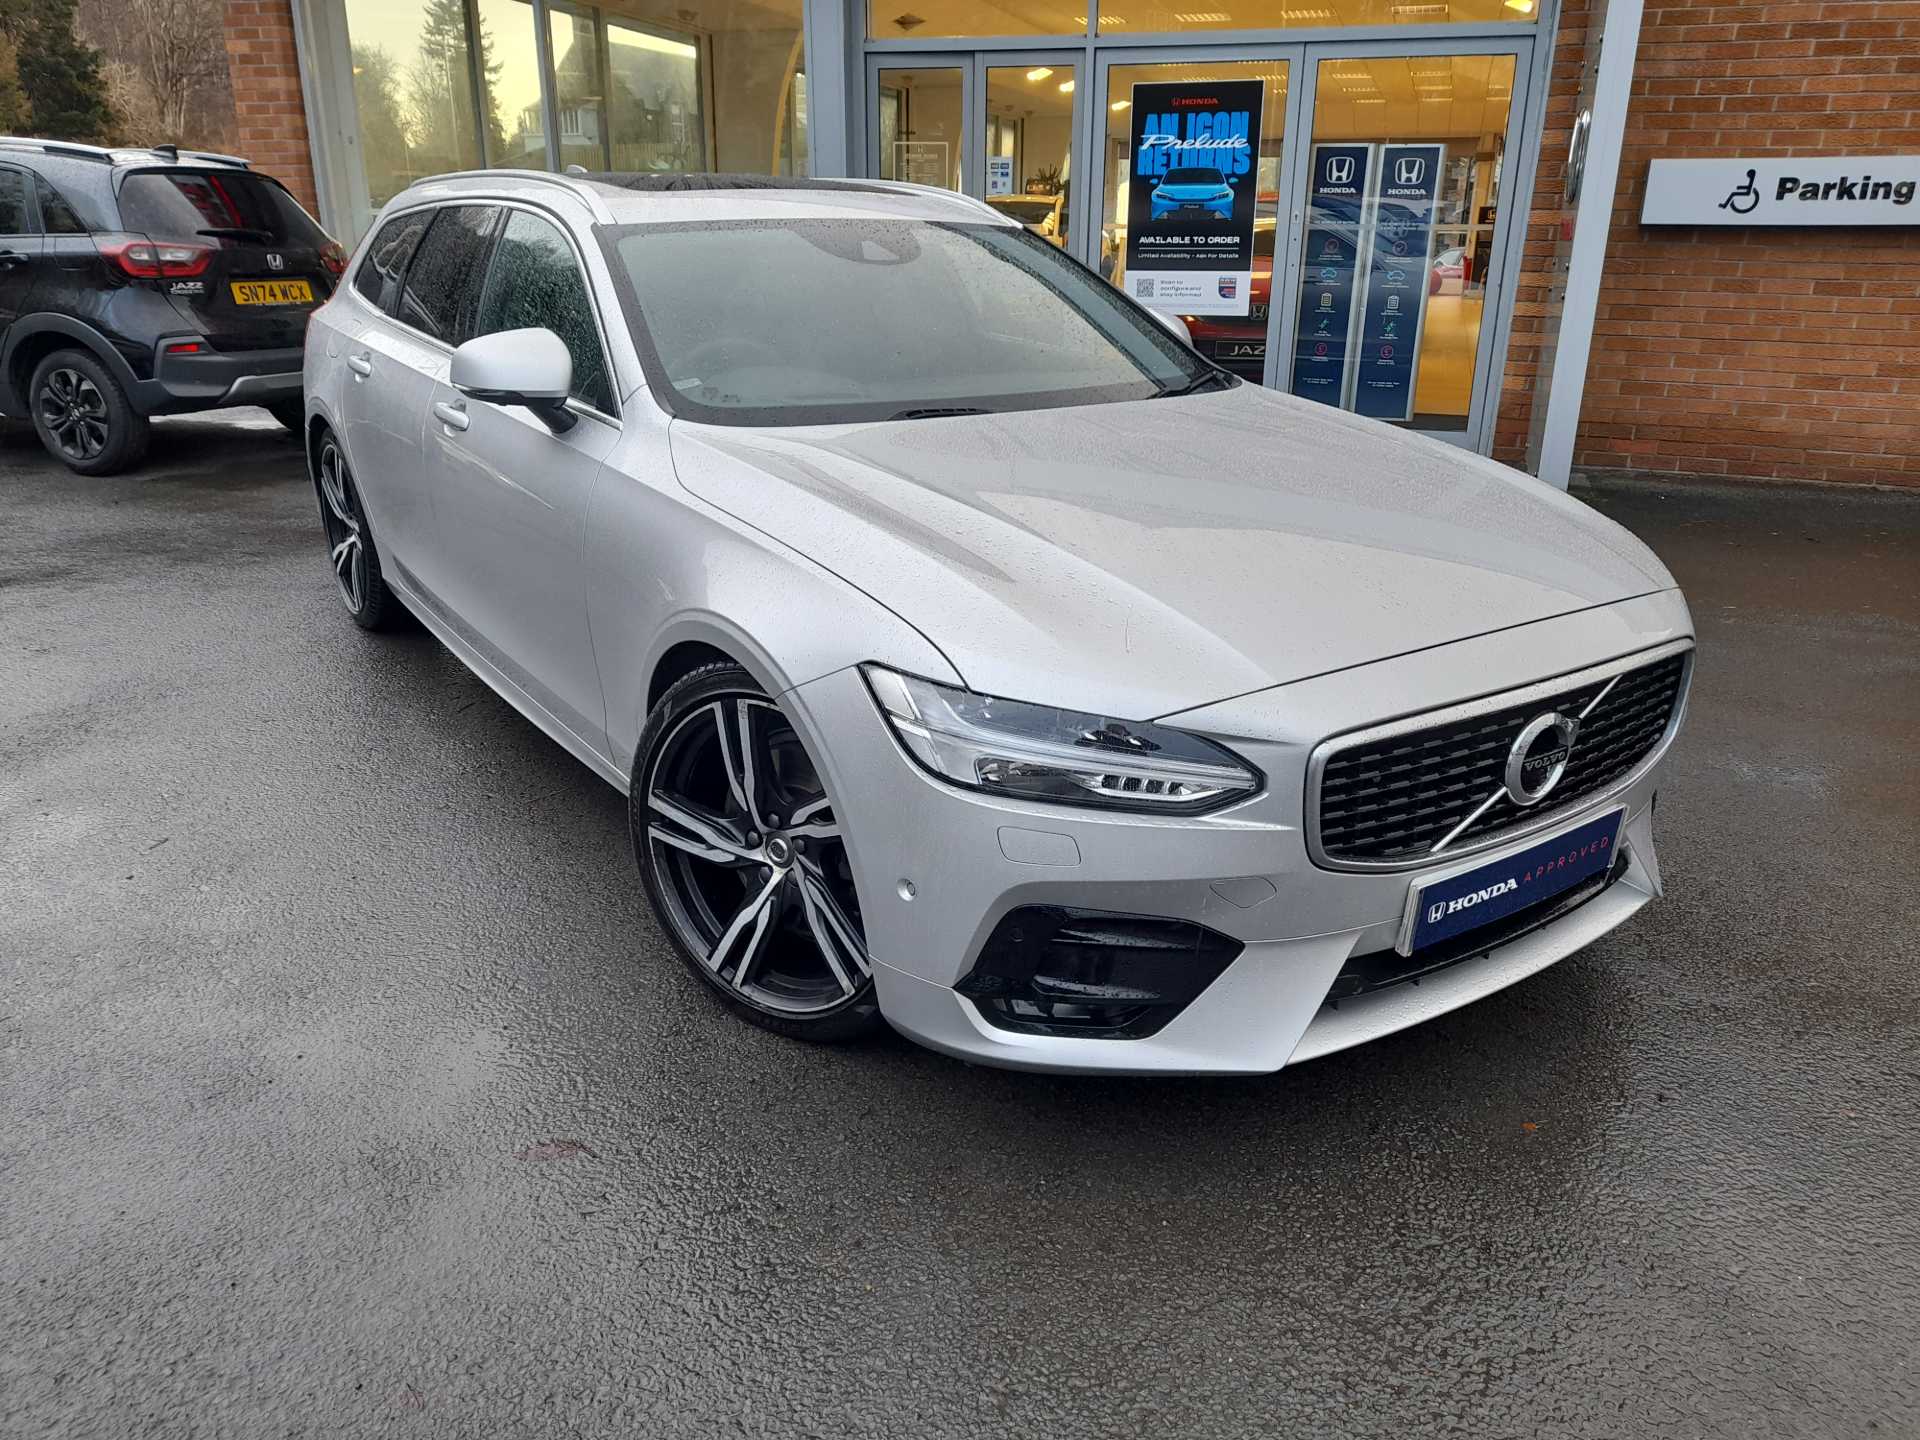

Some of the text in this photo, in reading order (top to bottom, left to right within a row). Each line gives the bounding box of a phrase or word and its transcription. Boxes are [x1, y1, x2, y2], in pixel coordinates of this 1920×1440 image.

[1143, 112, 1249, 144] AN ICON
[1140, 133, 1249, 150] Prelude
[1137, 145, 1251, 175] RETURNS
[1776, 175, 1917, 205] Parking
[1139, 236, 1240, 244] AVAILABLE TO ORDER
[170, 281, 204, 290] JAZZ
[239, 284, 307, 302] SN74 WCX
[1524, 751, 1565, 770] VOLVO
[1446, 836, 1609, 914] HONDA APPROVED
